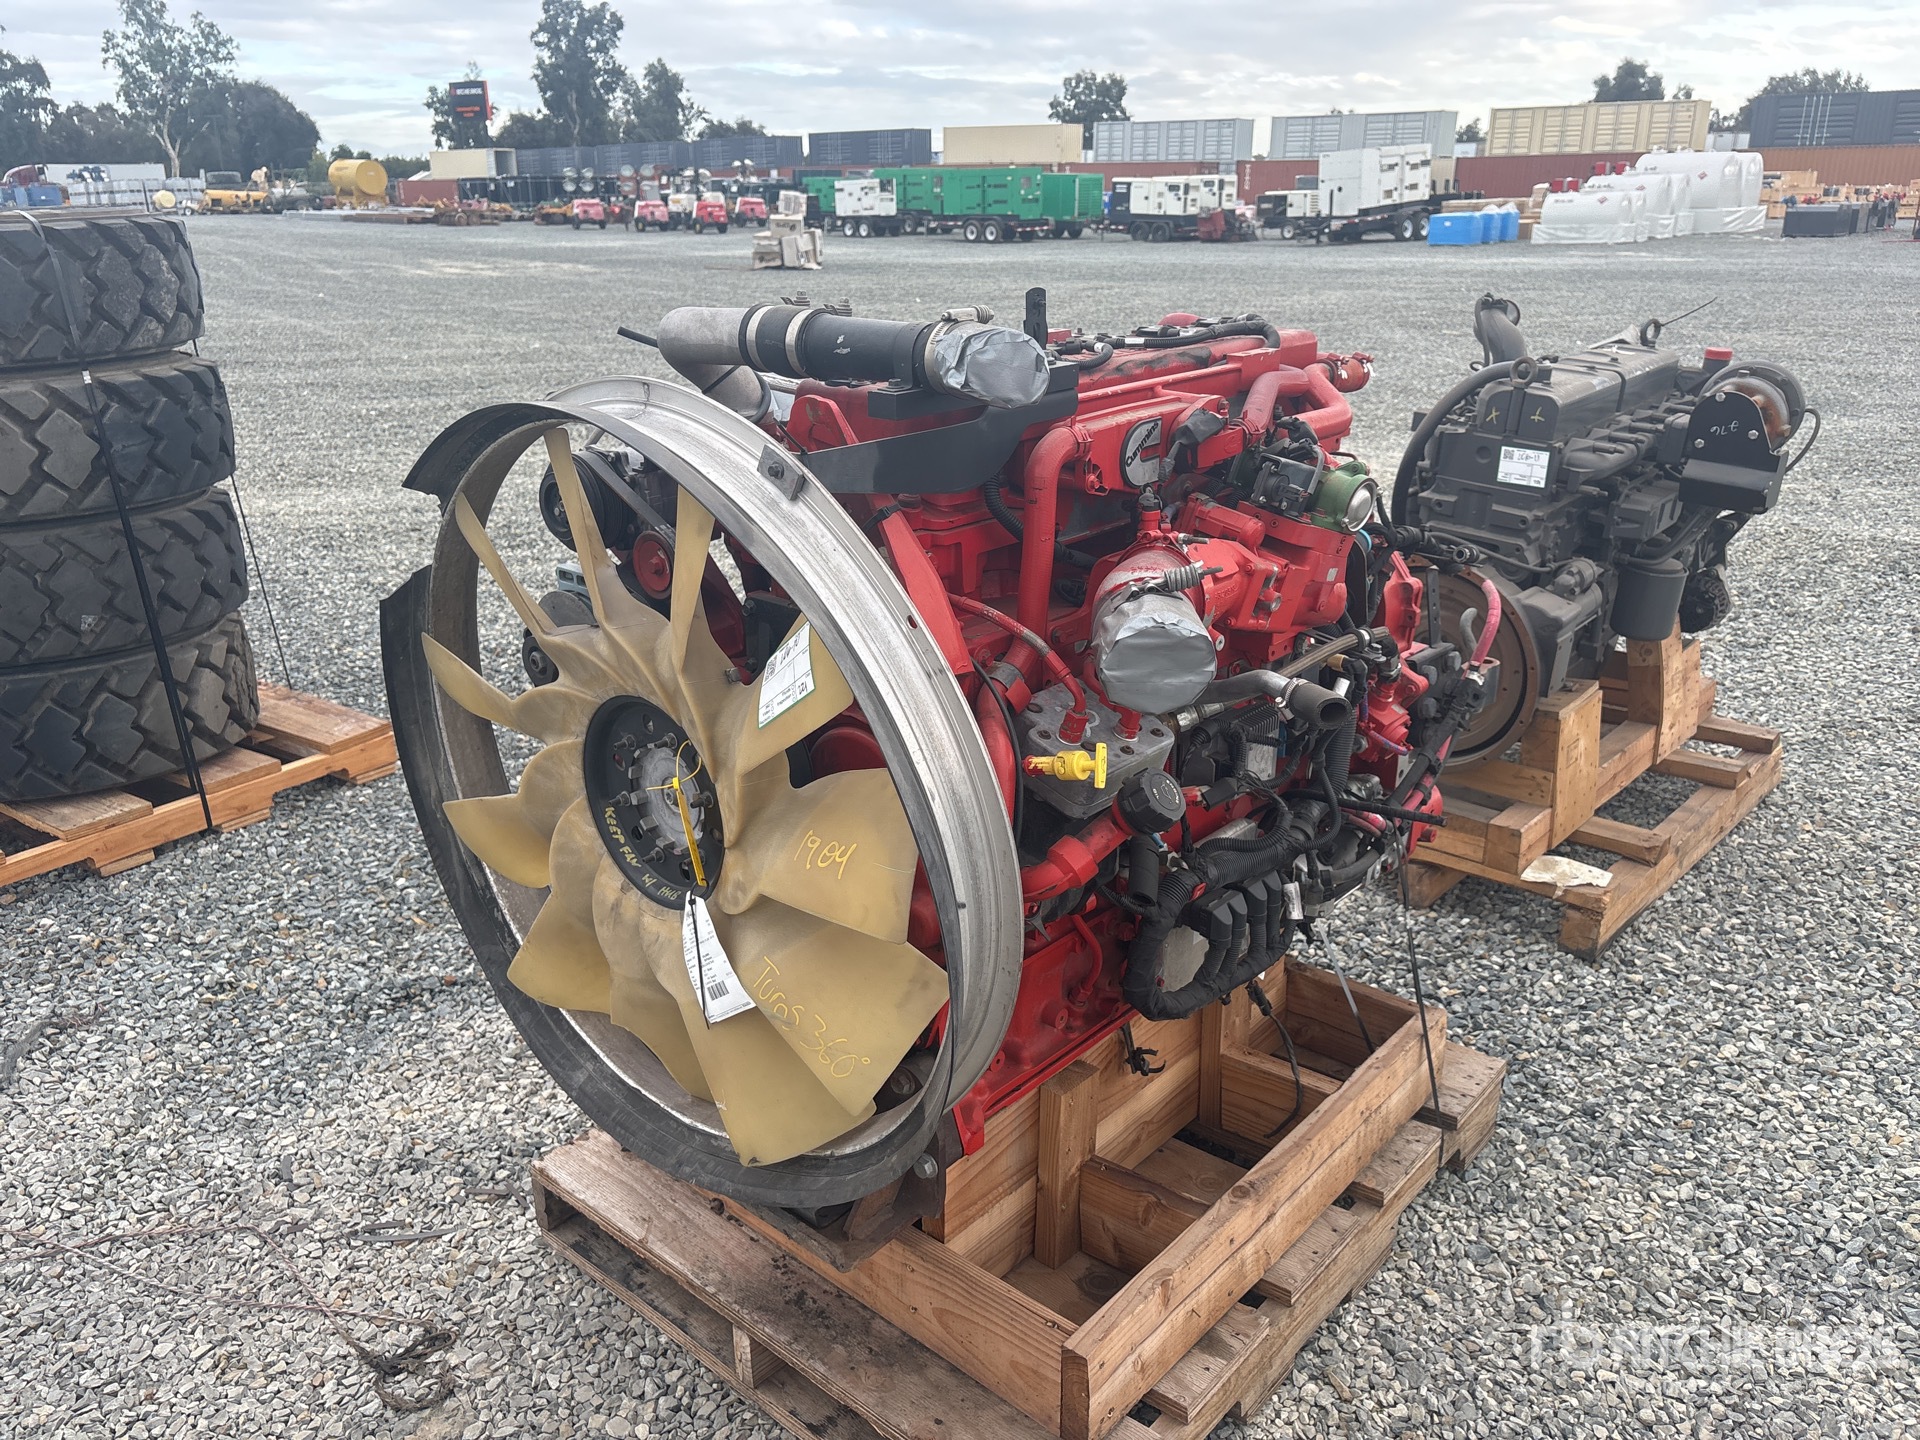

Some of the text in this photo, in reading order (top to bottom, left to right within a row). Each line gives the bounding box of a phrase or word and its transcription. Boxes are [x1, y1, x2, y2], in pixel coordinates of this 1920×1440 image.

[1125, 421, 1159, 467] Cummins
[604, 806, 625, 844] KEEP
[619, 846, 642, 868] FAN
[657, 885, 682, 900] HUB
[794, 829, 857, 880] 1904
[753, 955, 805, 1031] Turns
